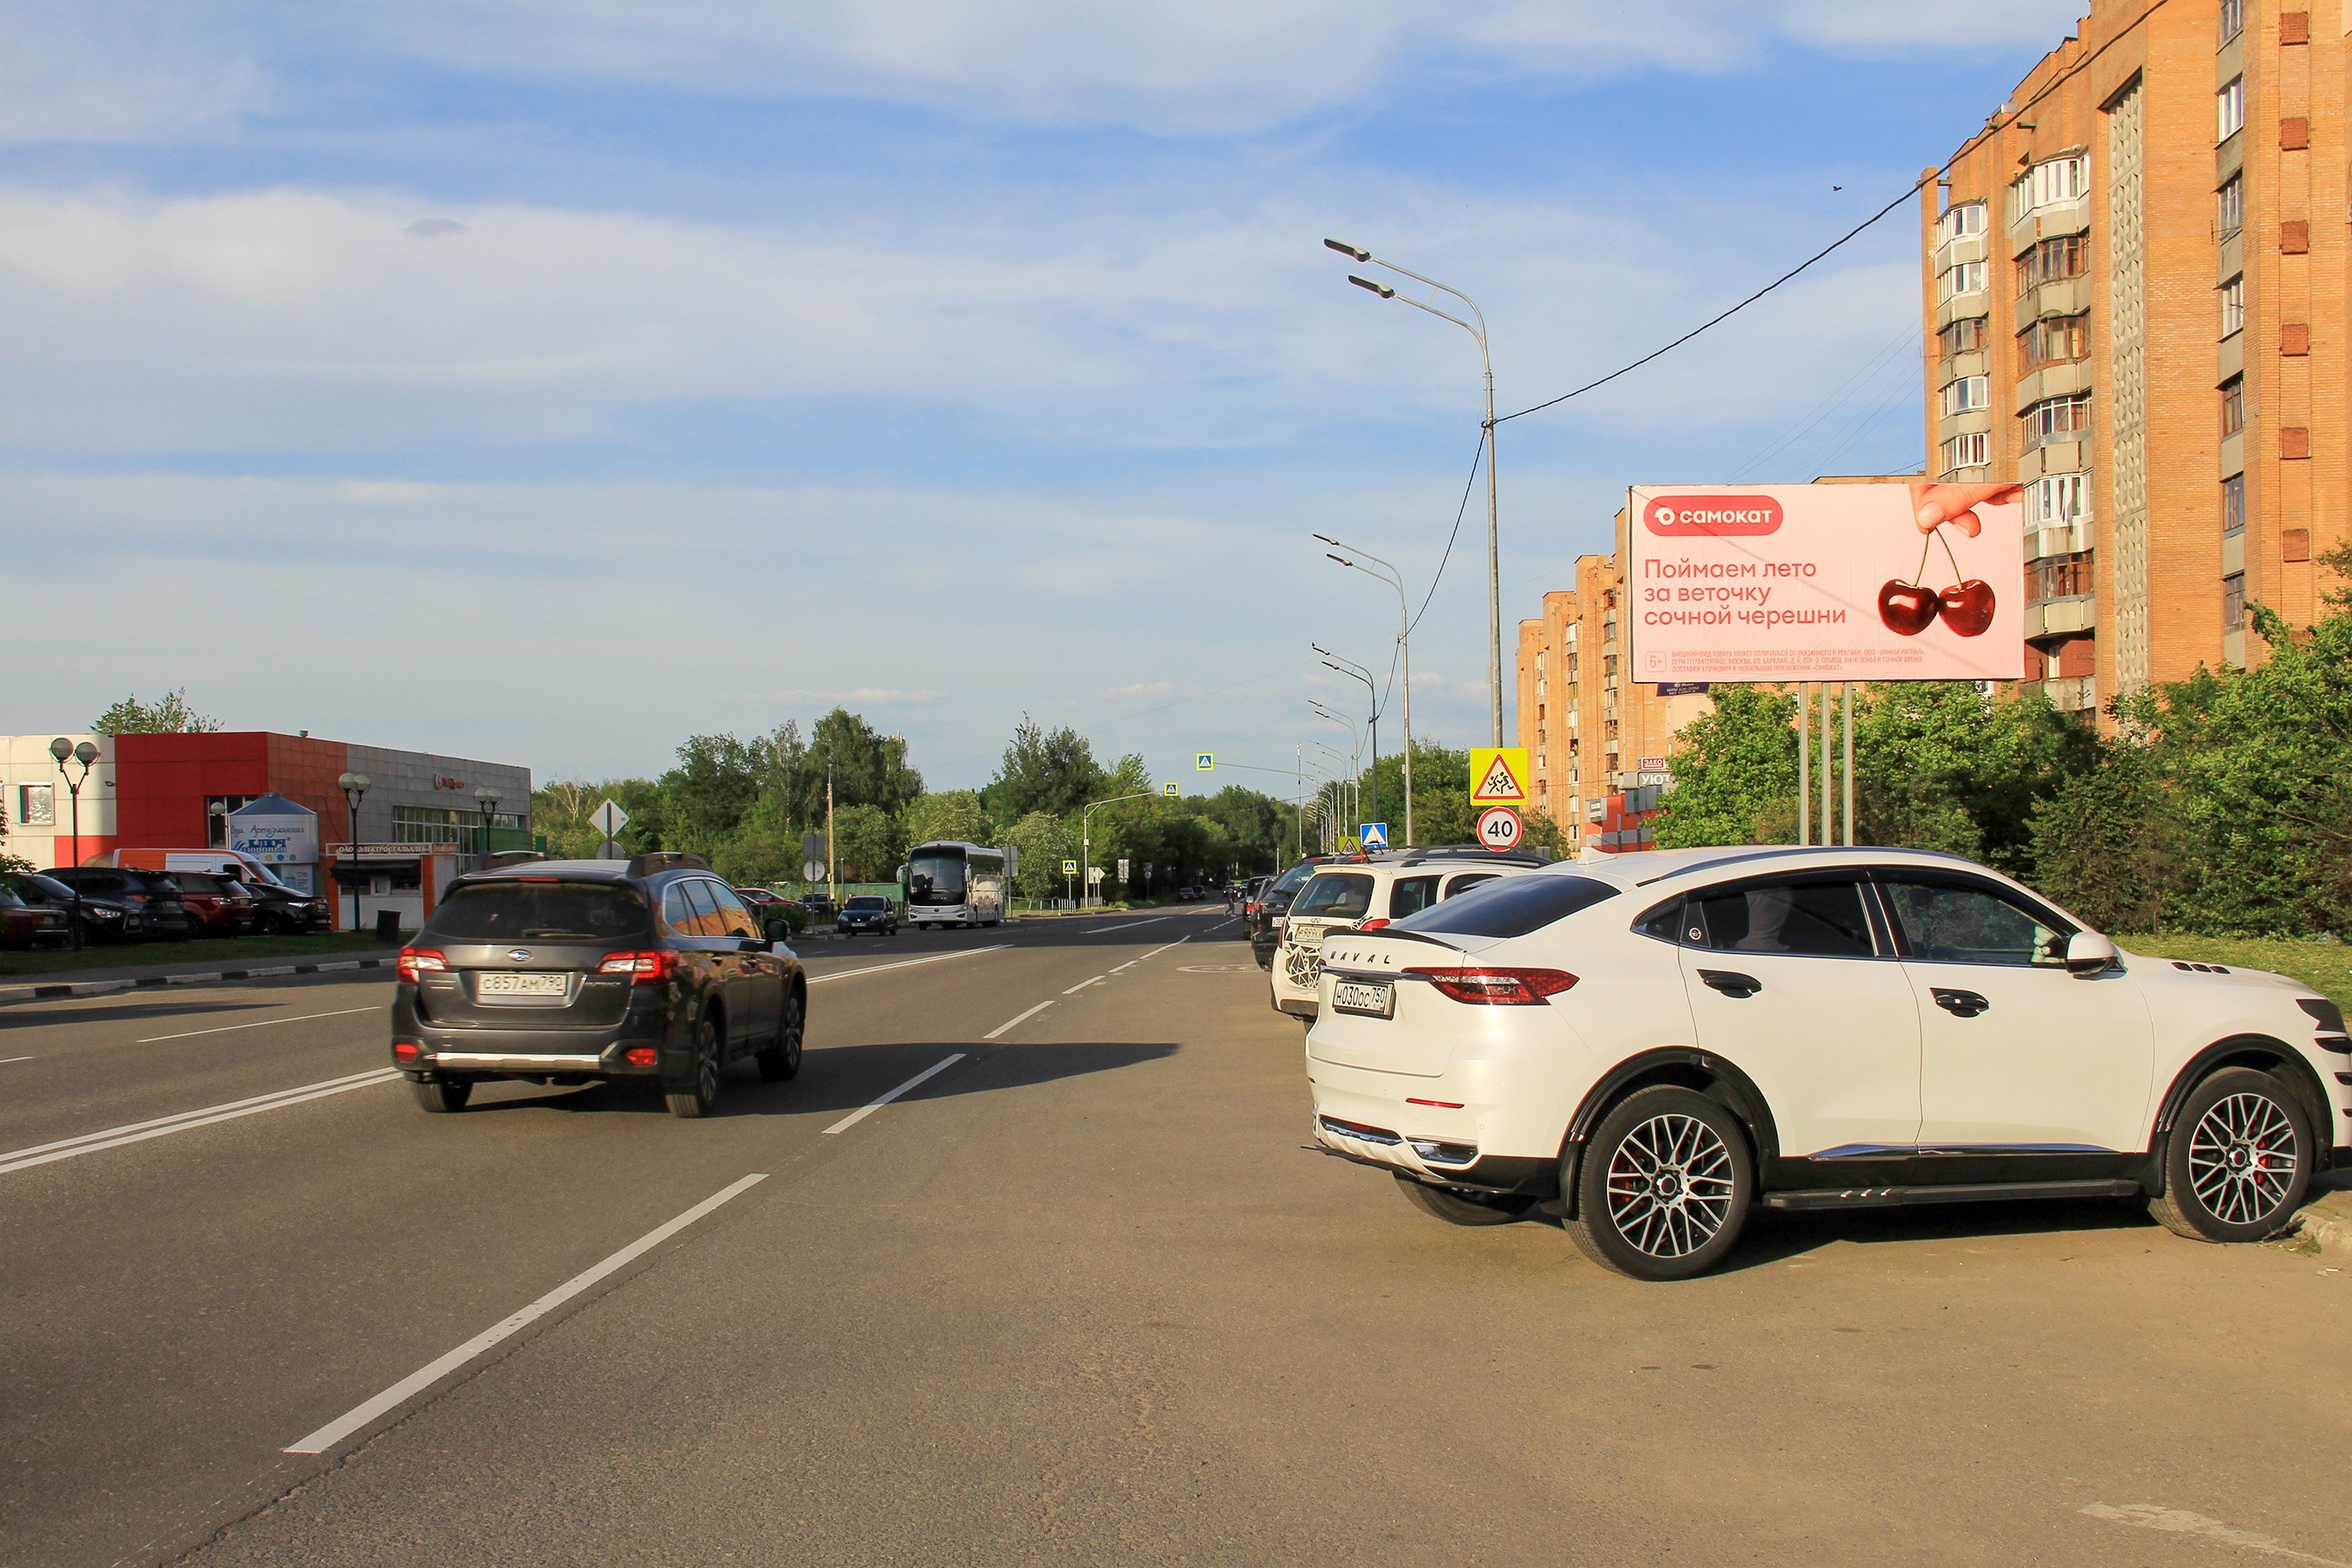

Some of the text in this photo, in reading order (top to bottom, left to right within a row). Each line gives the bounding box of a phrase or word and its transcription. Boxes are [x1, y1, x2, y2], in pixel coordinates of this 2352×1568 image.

[1679, 509, 1774, 524] самокат
[1644, 558, 1817, 578] Поймаем лето
[1643, 586, 1772, 606] за веточку
[1643, 604, 1846, 630] сочной черешни
[1649, 654, 1663, 668] 6+
[1640, 774, 1671, 785] УЮТ
[1487, 820, 1513, 837] 40
